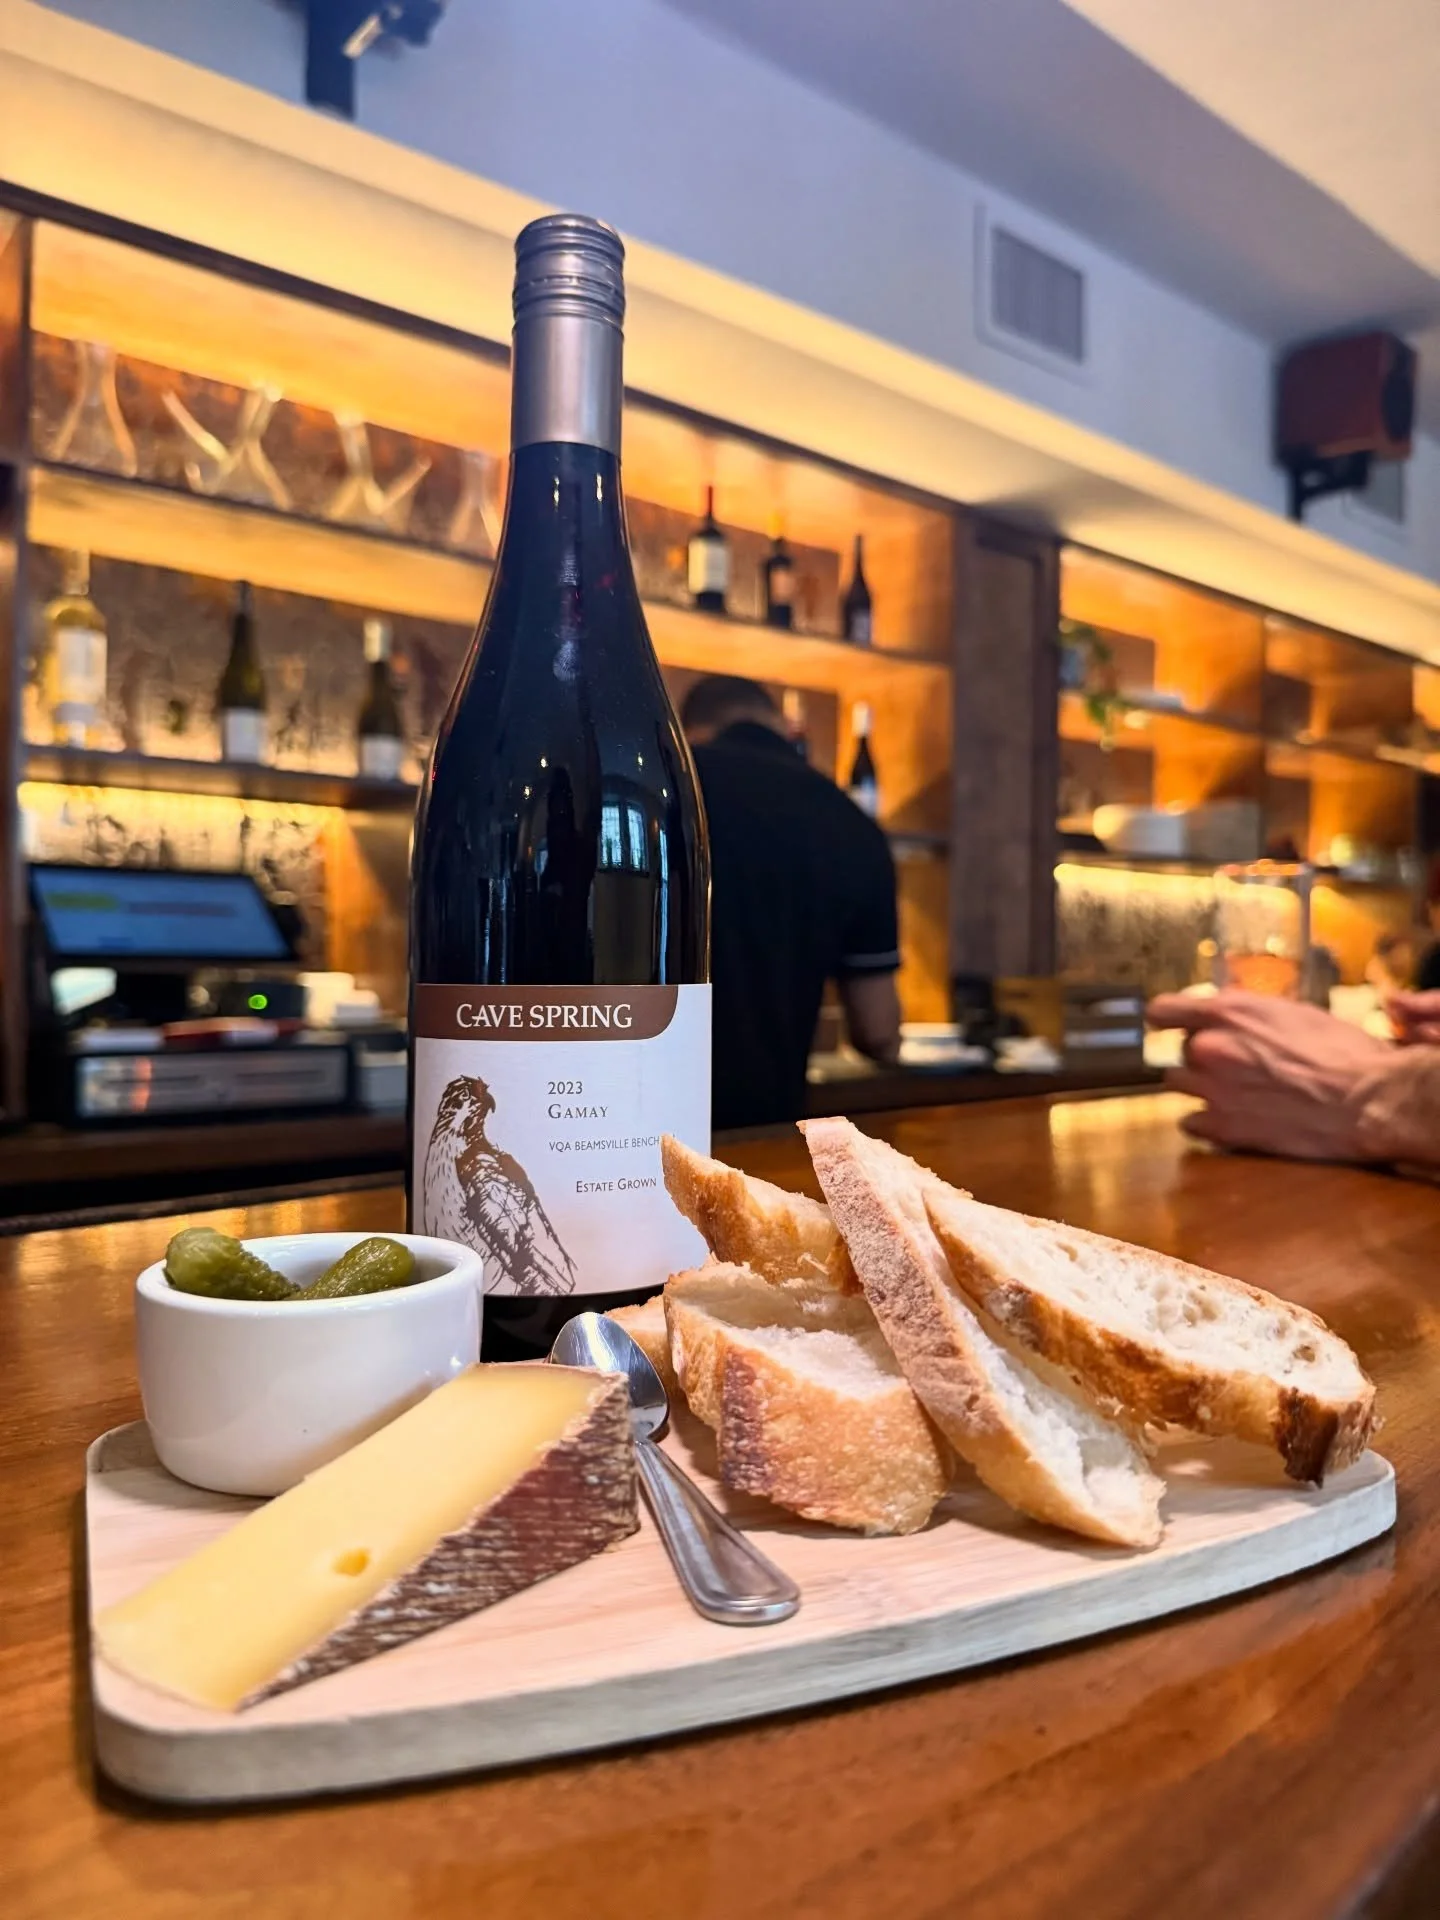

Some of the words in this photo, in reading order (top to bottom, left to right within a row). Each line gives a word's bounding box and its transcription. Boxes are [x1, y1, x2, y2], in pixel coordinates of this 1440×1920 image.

[456, 1003, 523, 1028] CAVE
[529, 1003, 632, 1028] SPRING
[547, 1081, 583, 1095] 2023
[547, 1103, 608, 1119] GAMAY
[549, 1141, 572, 1153] VQA
[574, 1138, 629, 1151] BEAMSVILLE
[632, 1136, 660, 1148] BENCH
[576, 1180, 614, 1193] ESTATE
[617, 1178, 657, 1190] GROWN
